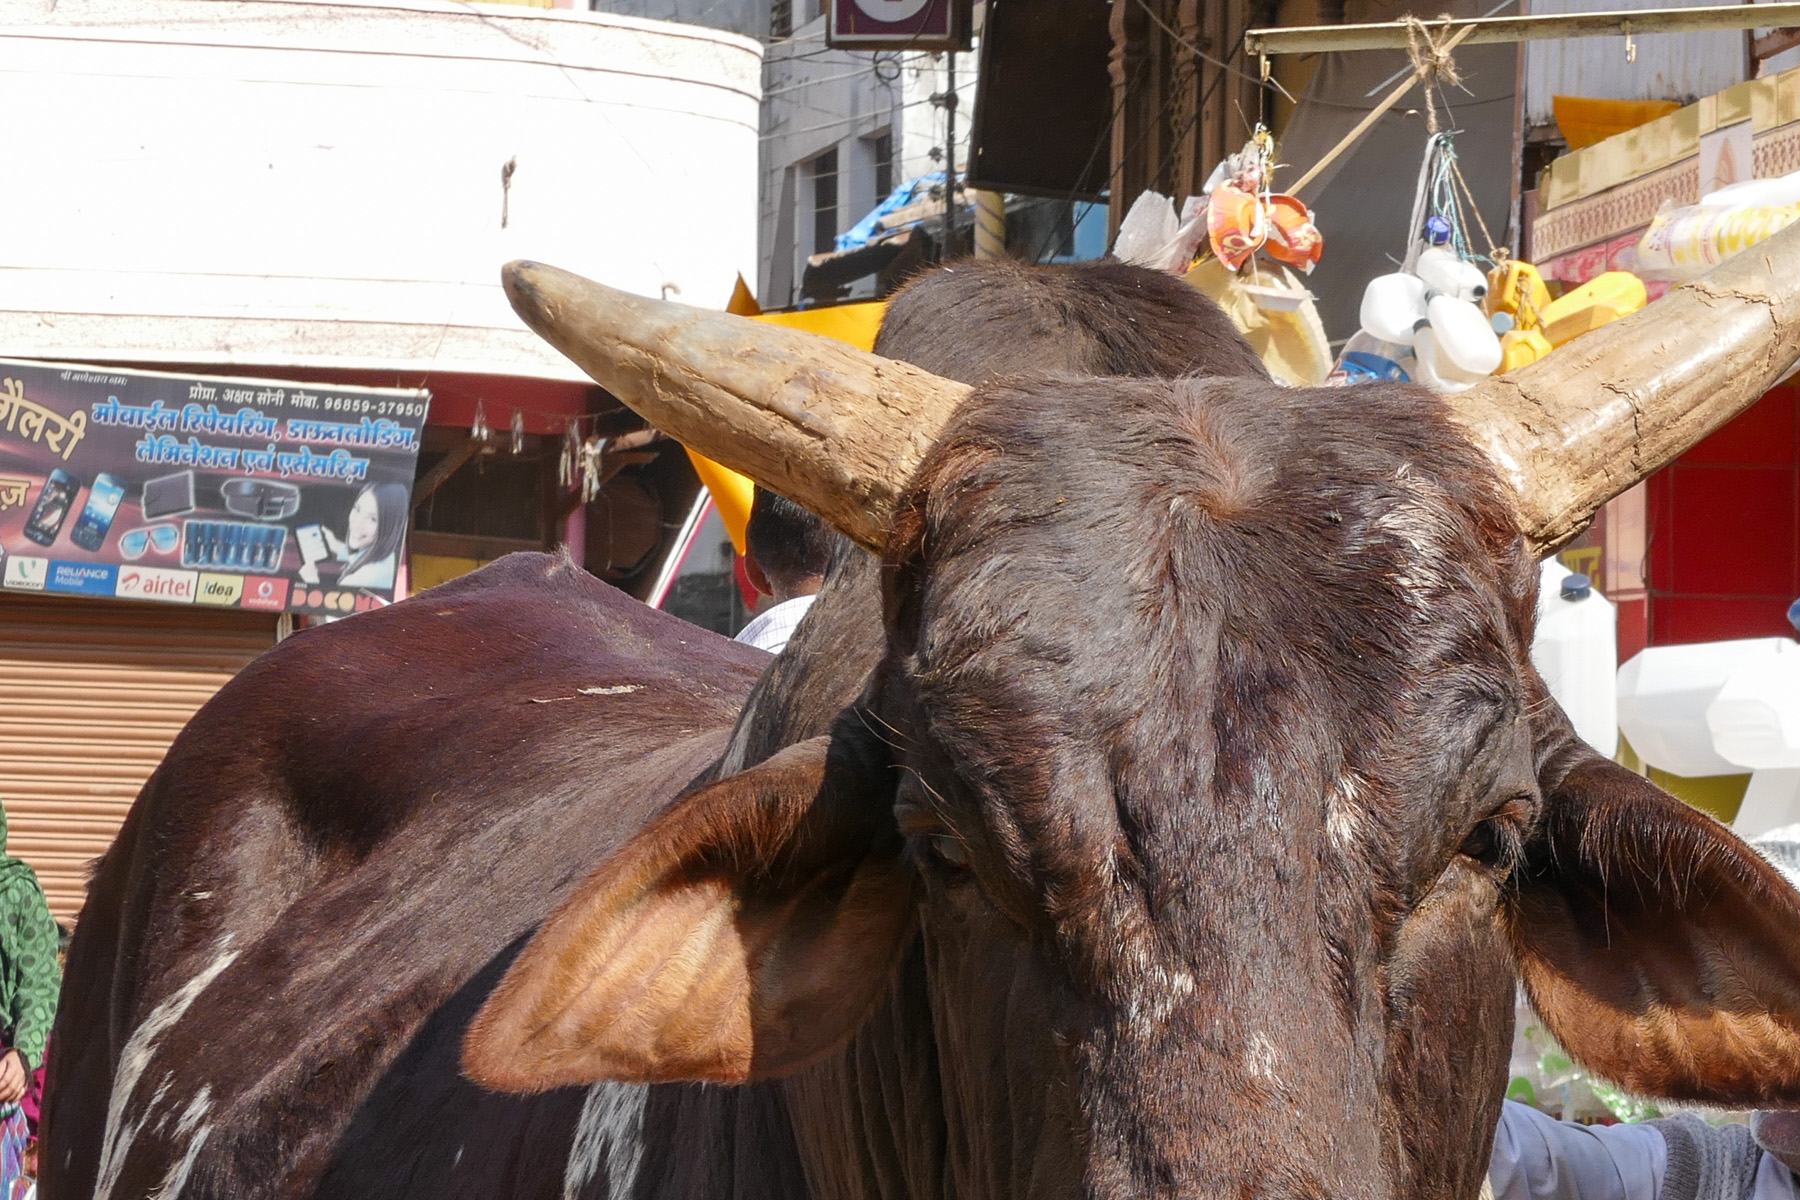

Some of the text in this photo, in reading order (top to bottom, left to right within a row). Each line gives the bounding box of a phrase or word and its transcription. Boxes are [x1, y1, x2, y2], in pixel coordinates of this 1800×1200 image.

[257, 388, 285, 406] सोनी
[325, 397, 423, 417] 96859-37950
[136, 433, 241, 470] लेमिनेशन
[242, 443, 276, 476] एवं
[55, 575, 85, 587] Mobile
[143, 575, 192, 597] airtel
